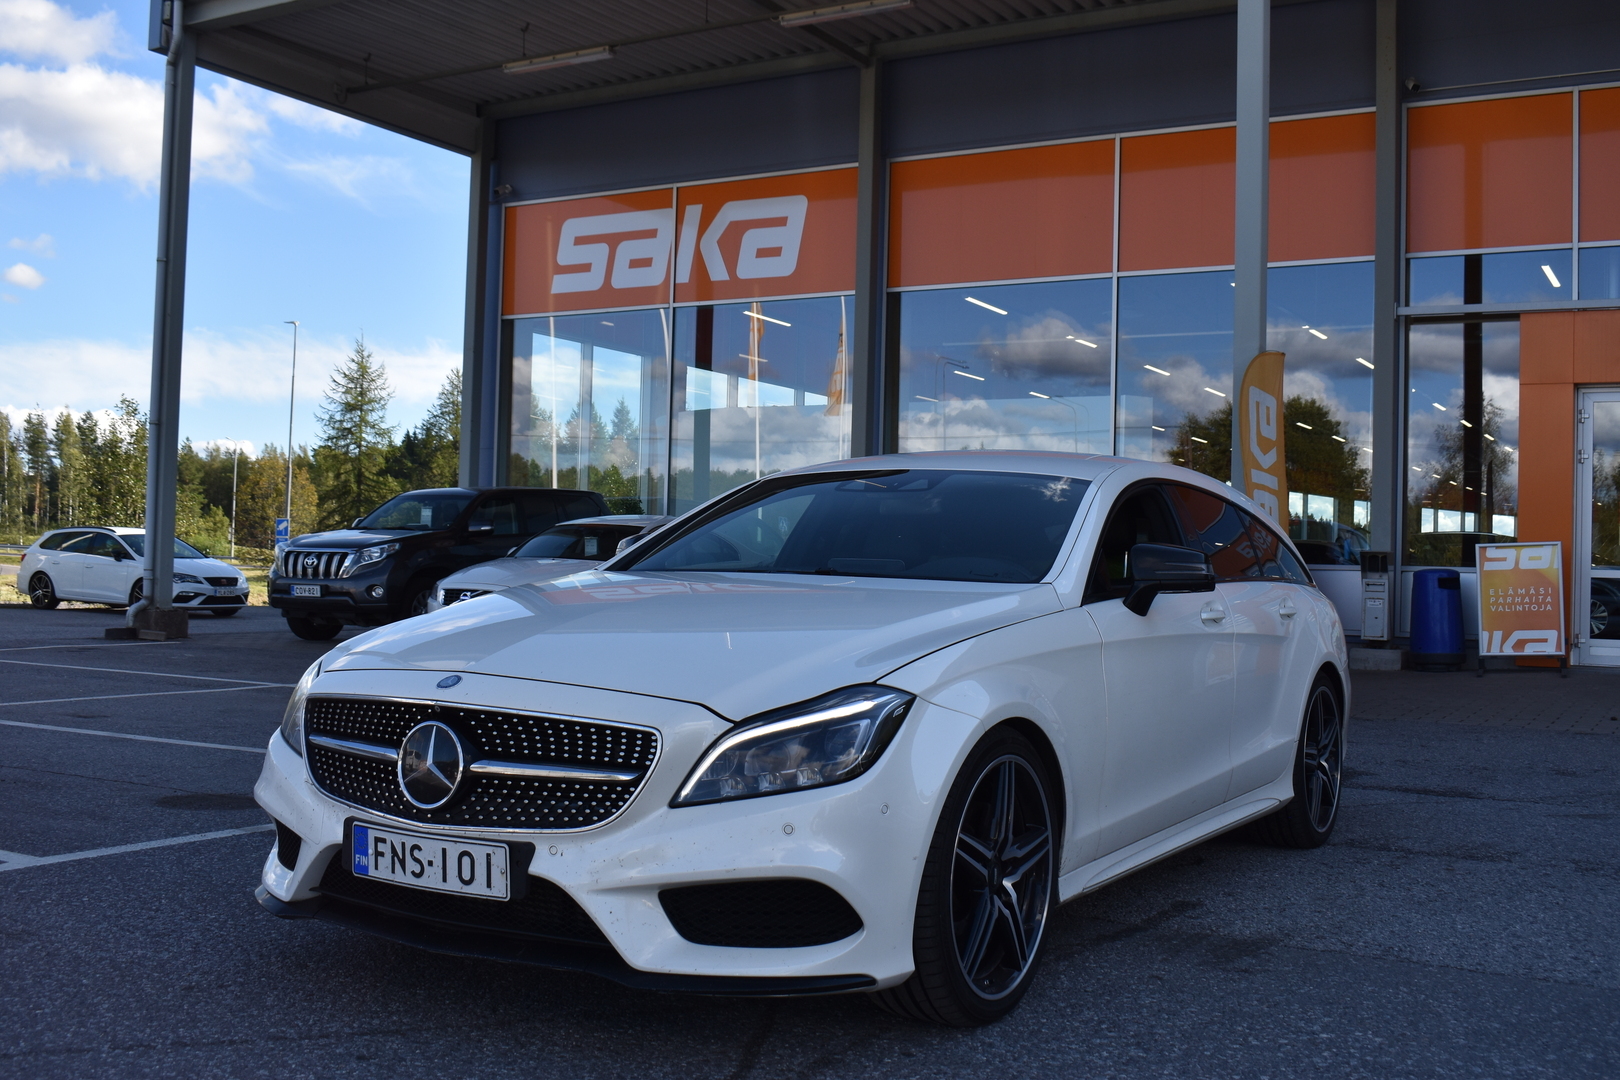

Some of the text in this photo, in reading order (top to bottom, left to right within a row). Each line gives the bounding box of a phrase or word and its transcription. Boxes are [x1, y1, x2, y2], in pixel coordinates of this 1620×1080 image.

[1489, 586, 1552, 595] ELÄMÄSI
[1489, 596, 1552, 604] PARHAITA
[1489, 604, 1553, 612] VALINTOJA
[355, 854, 368, 867] FIN
[373, 835, 492, 889] FNS-101
